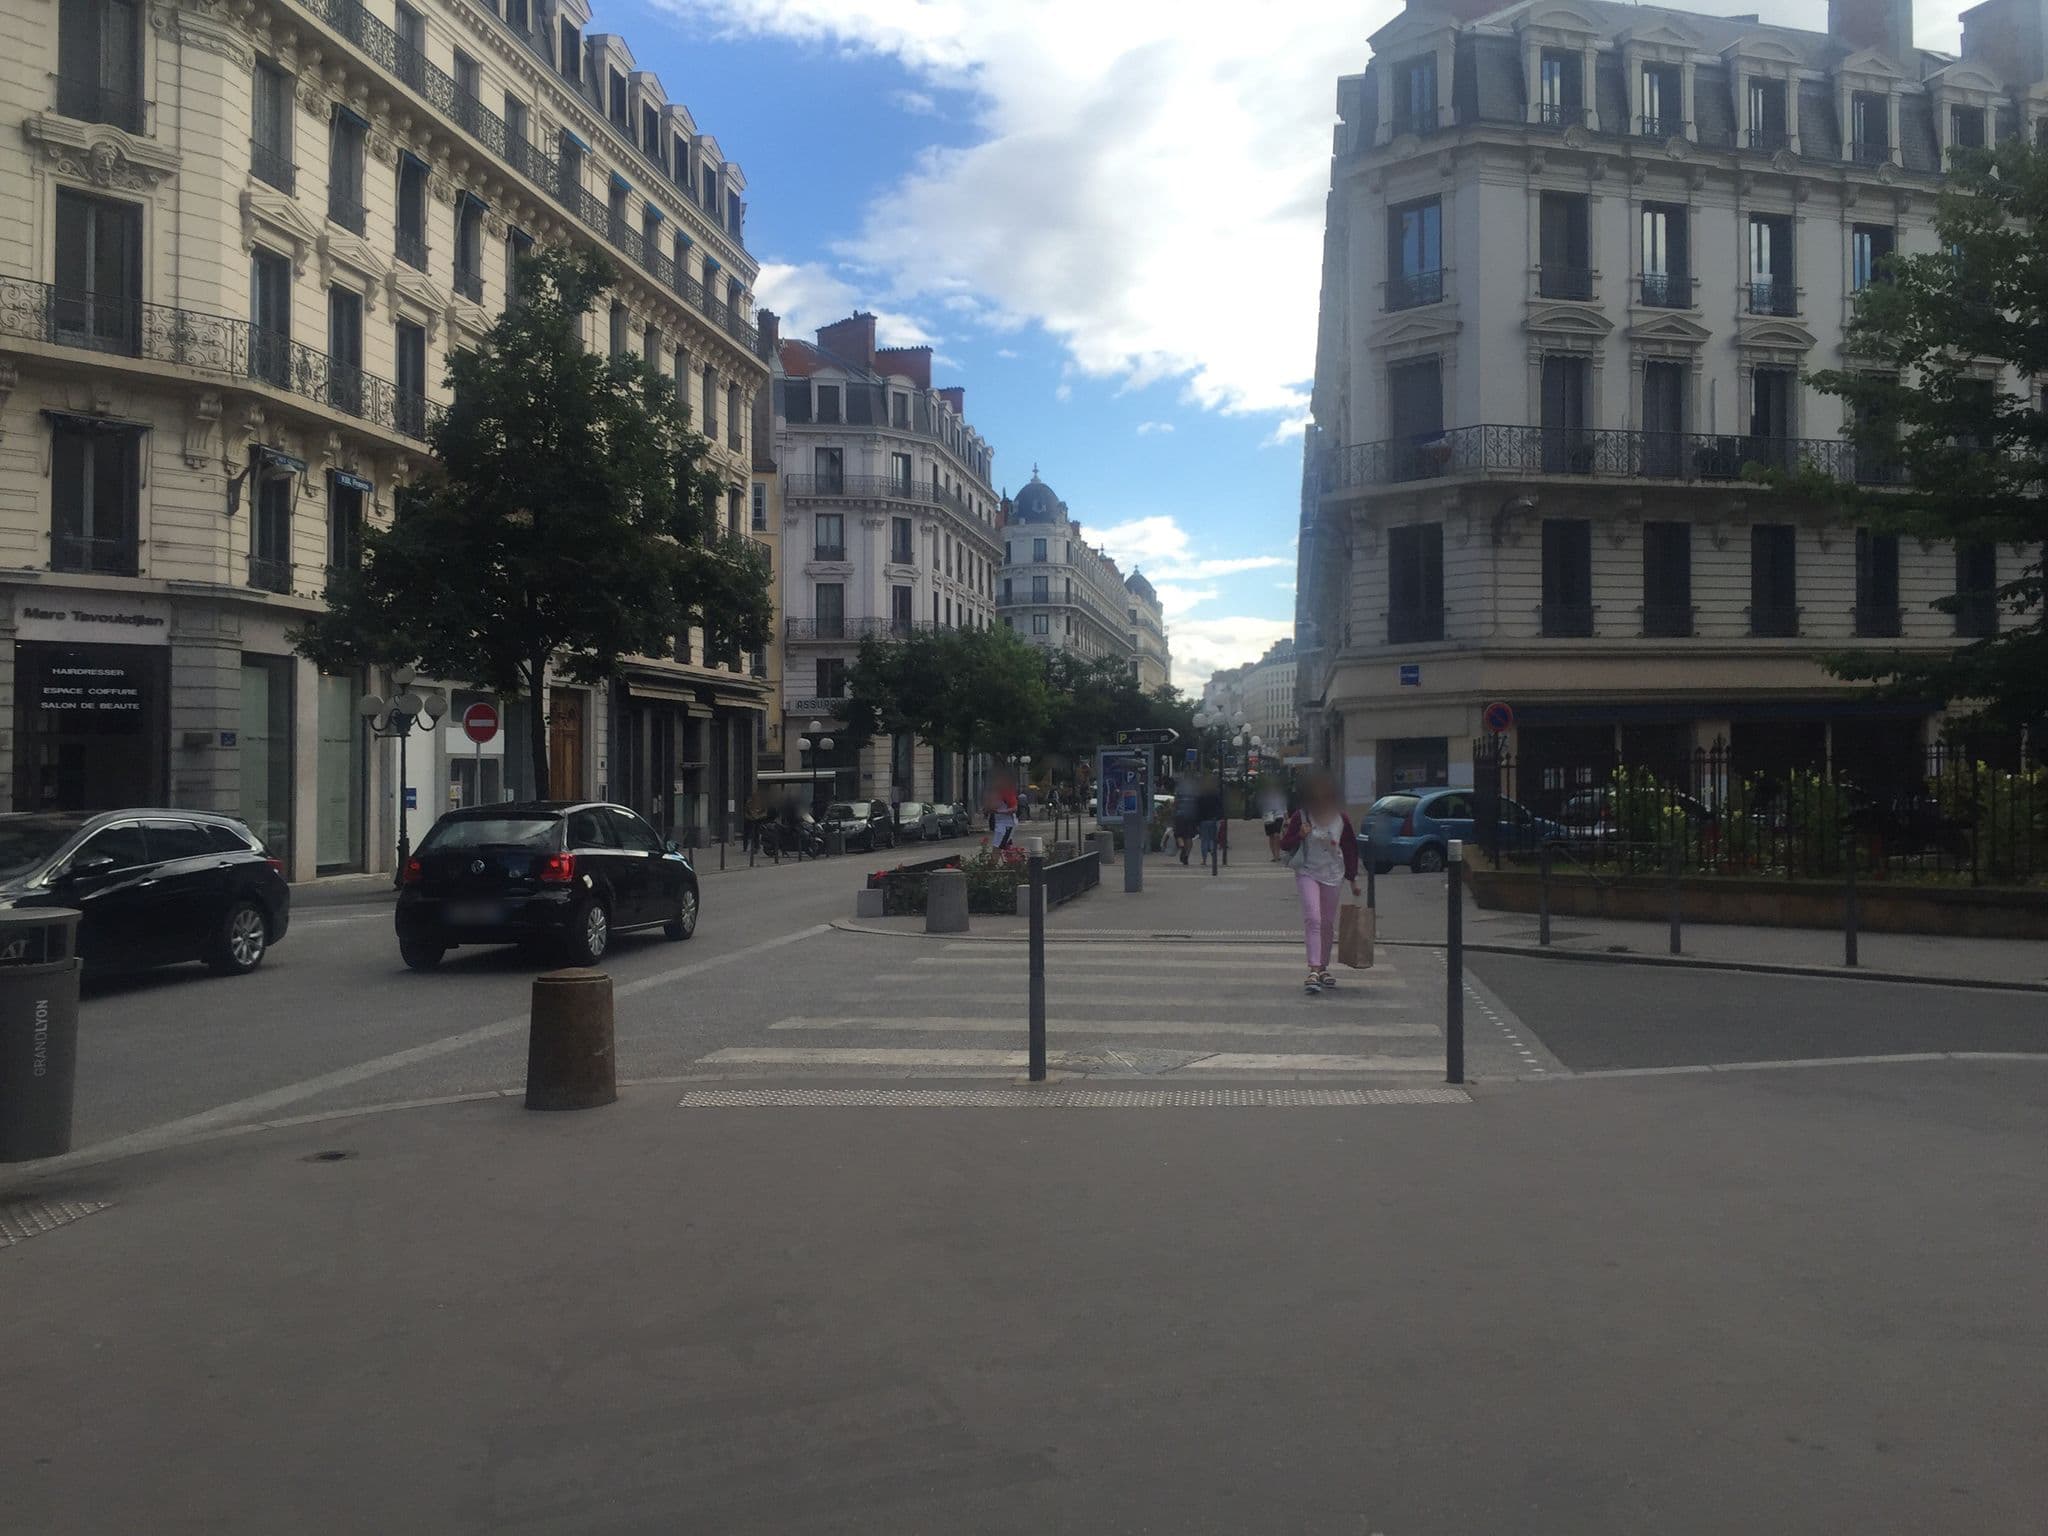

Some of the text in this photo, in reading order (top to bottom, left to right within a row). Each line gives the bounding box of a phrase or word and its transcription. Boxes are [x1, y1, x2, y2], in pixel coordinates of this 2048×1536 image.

[23, 608, 66, 619] Marc
[52, 668, 125, 676] HAIRDRESSER
[87, 688, 138, 696] COIFFURE
[1120, 733, 1128, 743] P
